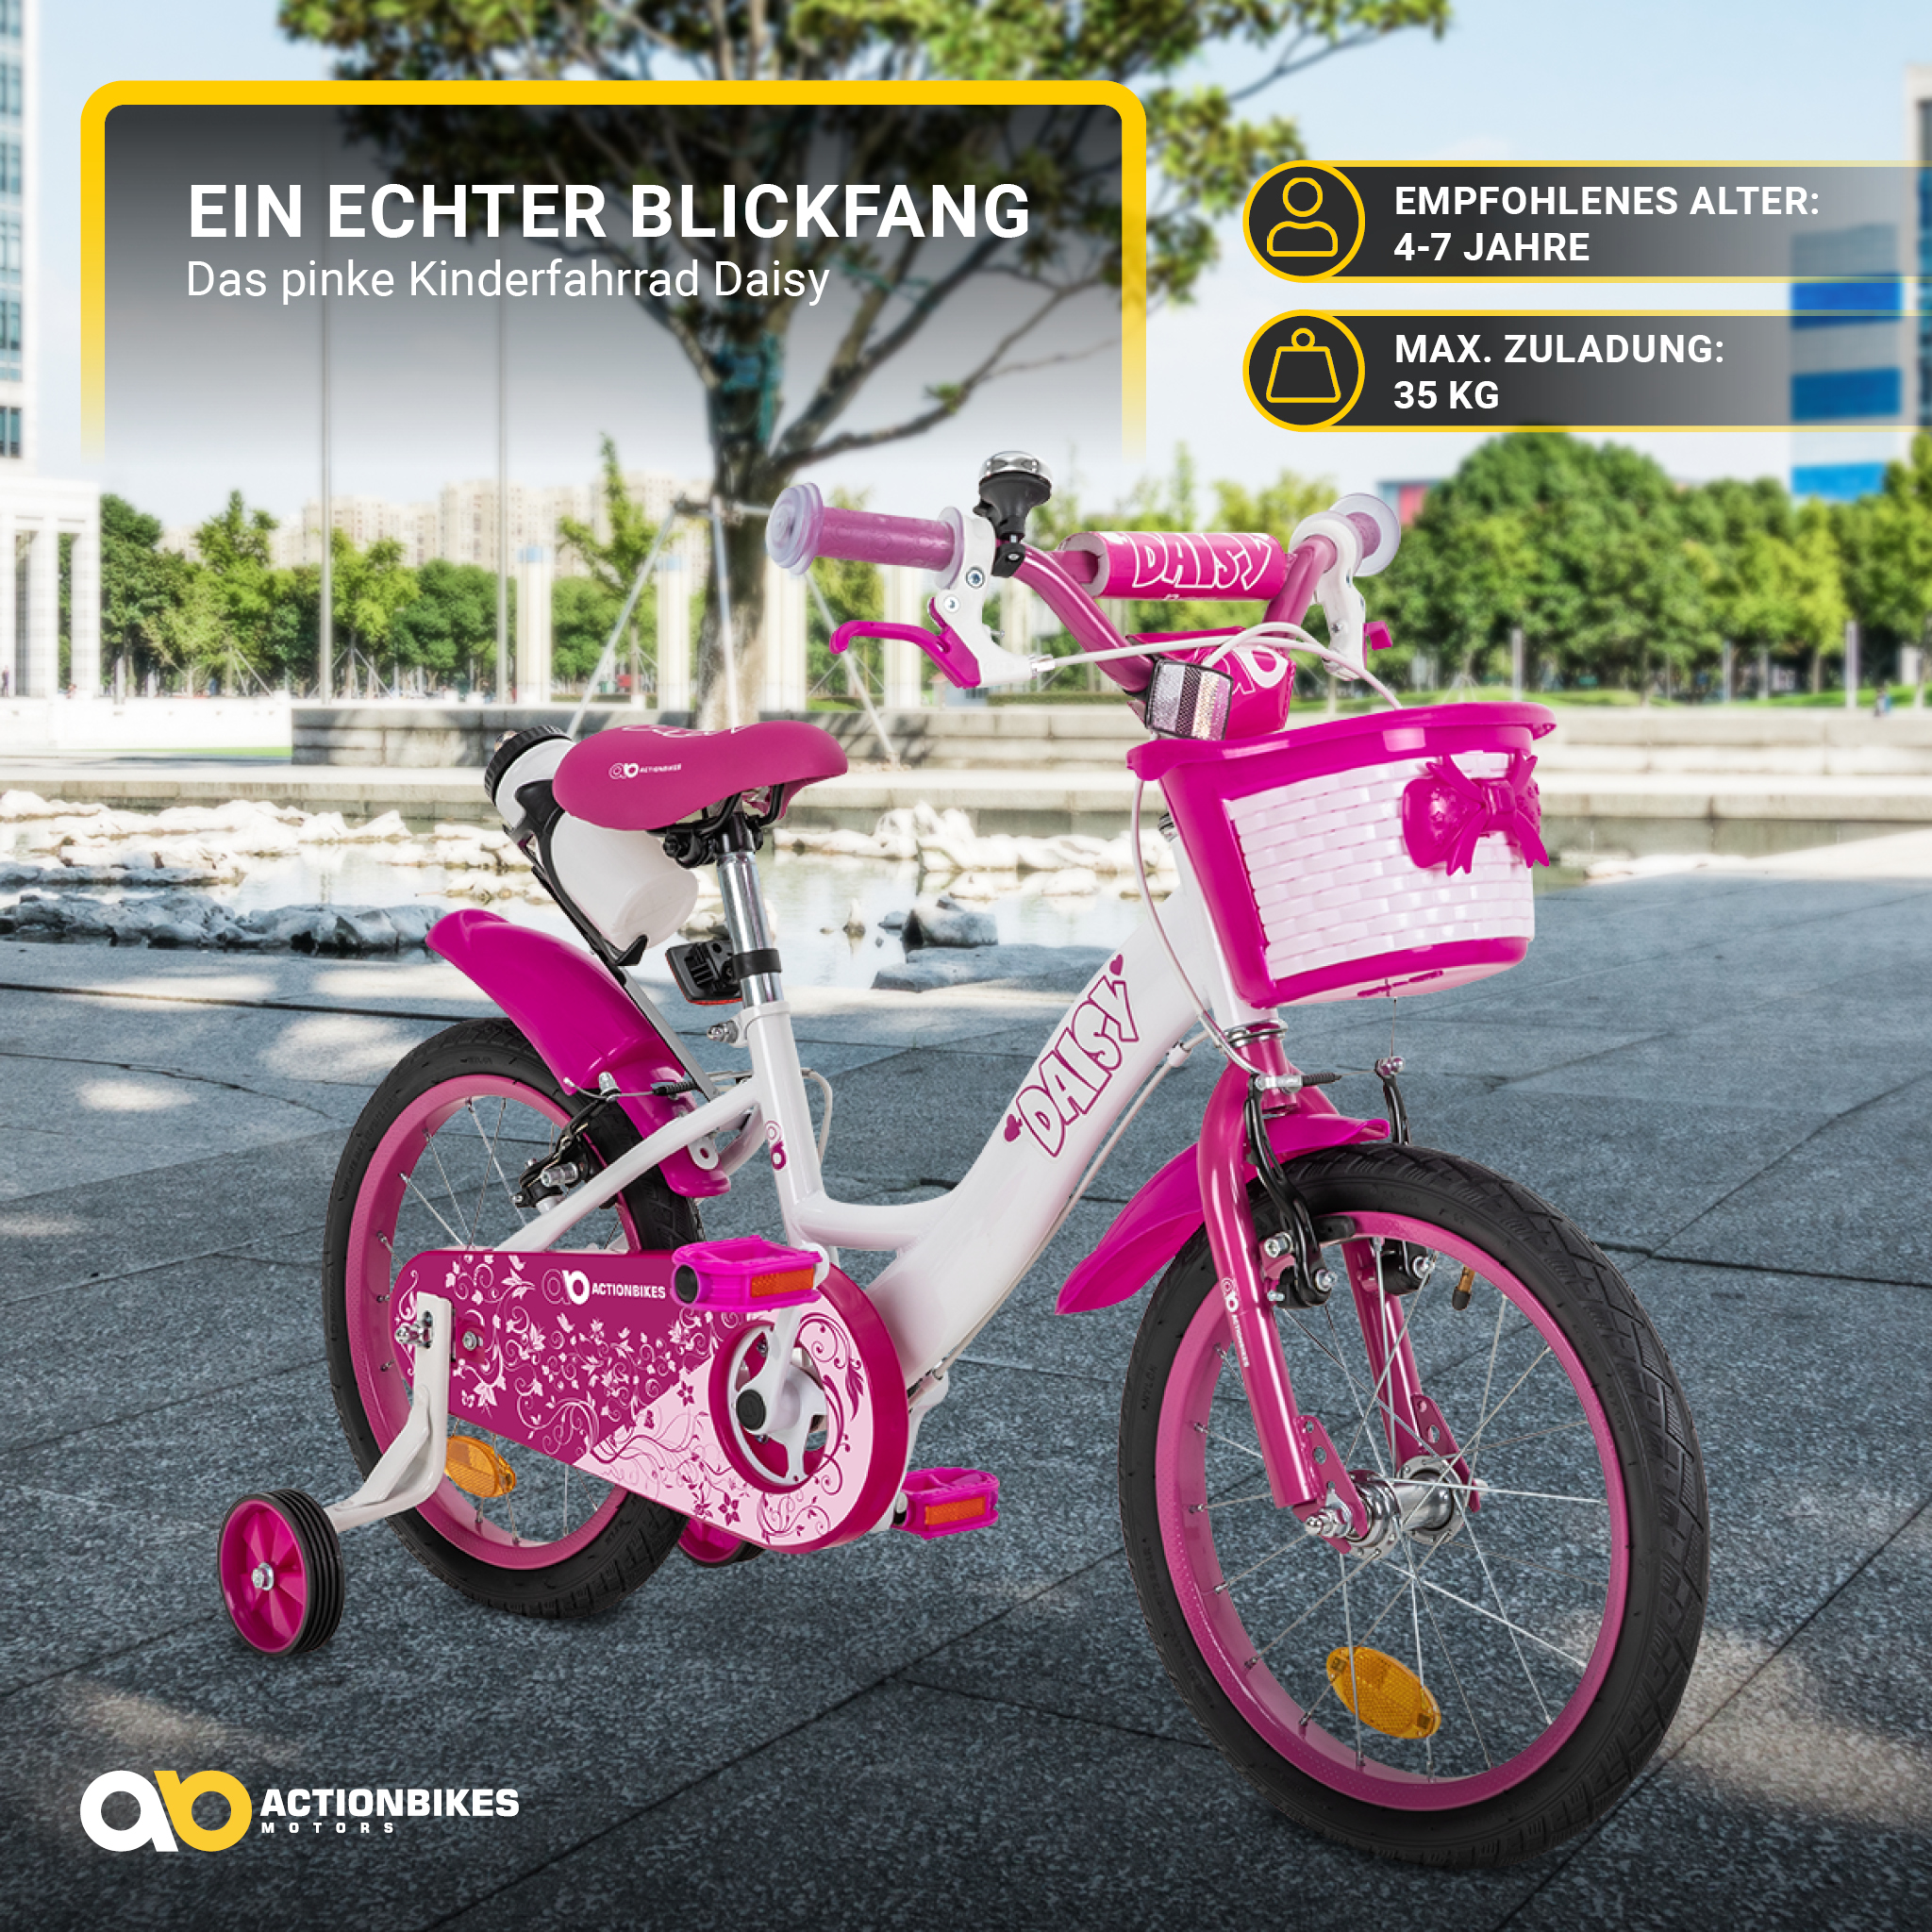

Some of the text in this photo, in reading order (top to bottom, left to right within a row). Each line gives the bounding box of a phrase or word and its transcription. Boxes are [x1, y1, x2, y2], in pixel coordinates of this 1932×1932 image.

[1131, 532, 1272, 591] DAISY
[1015, 974, 1140, 1158] DAISY
[591, 1282, 666, 1299] ACTIONBIKES
